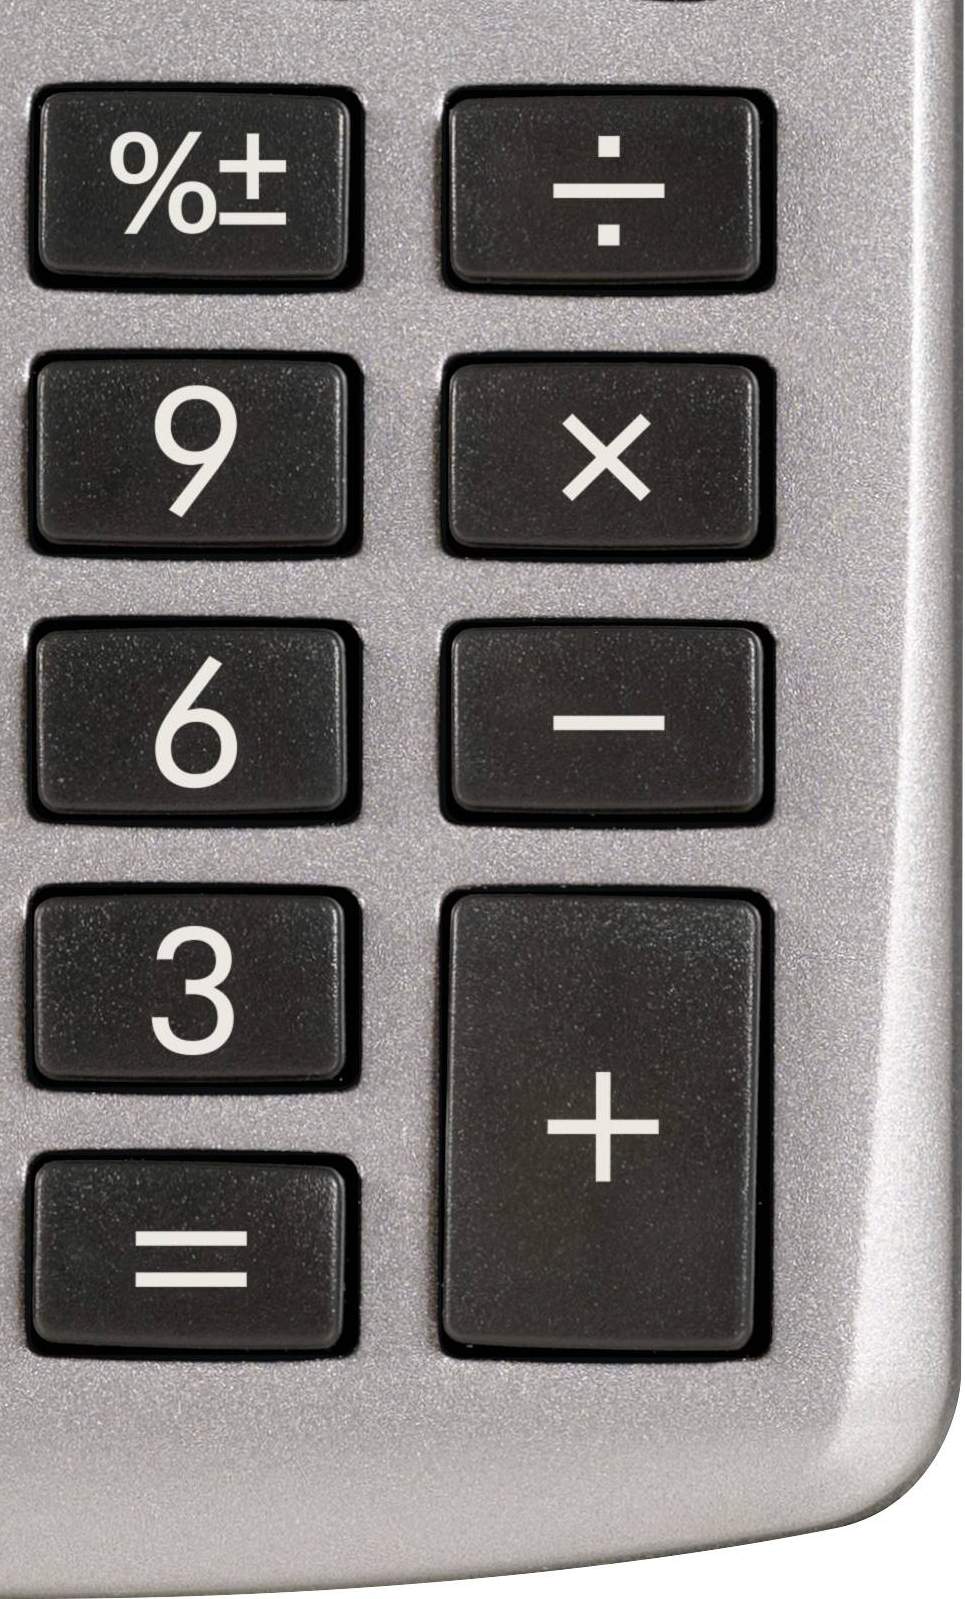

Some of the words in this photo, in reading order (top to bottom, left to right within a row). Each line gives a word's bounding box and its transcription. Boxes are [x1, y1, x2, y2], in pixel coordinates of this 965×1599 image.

[155, 385, 237, 517] 9
[155, 656, 237, 788] 6
[152, 926, 234, 1055] 3
